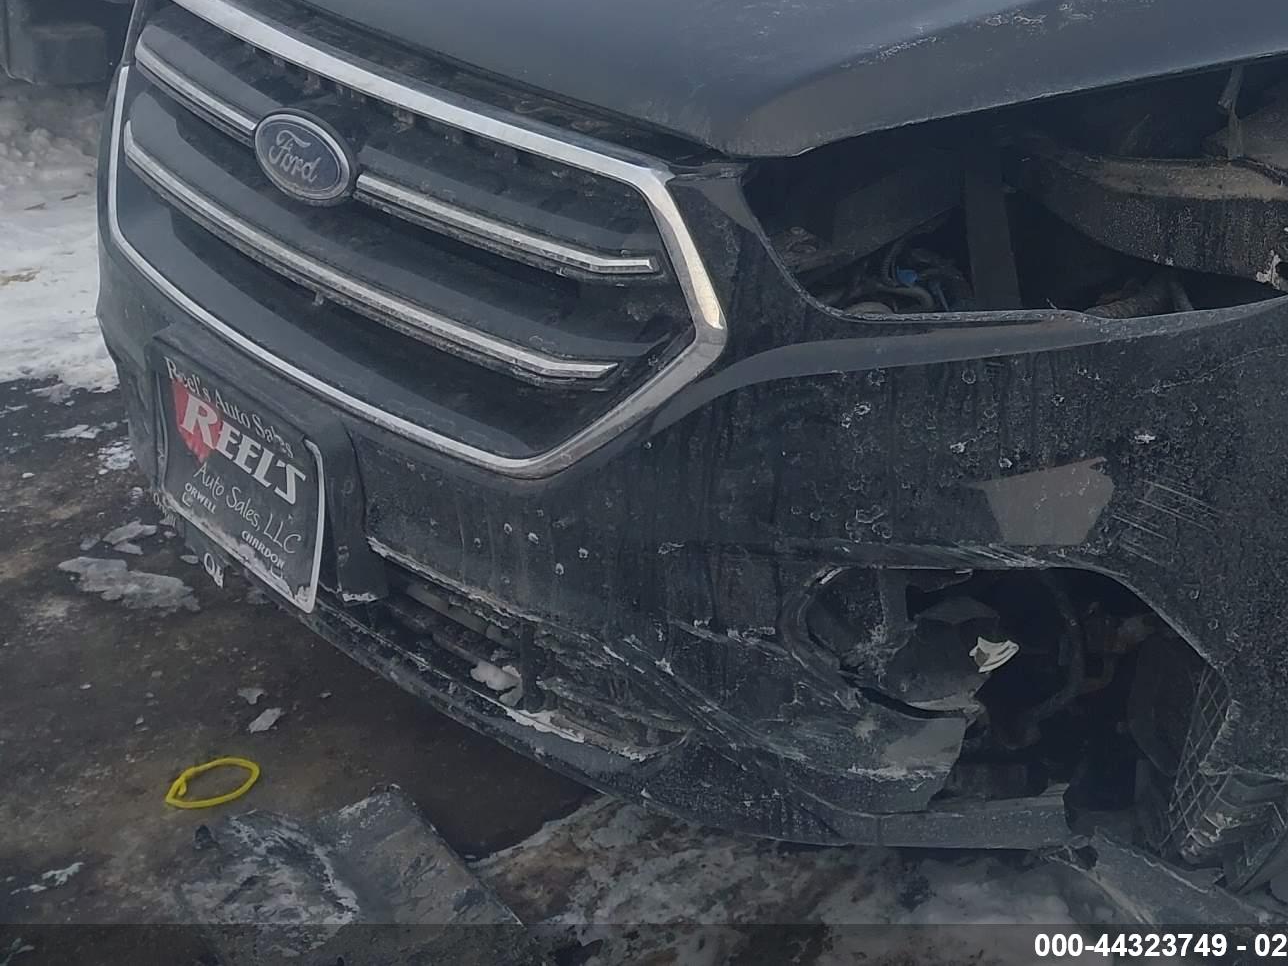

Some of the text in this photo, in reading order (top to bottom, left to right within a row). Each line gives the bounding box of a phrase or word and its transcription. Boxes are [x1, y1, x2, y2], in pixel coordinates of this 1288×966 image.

[268, 129, 322, 183] Ford
[215, 389, 251, 429] Auto
[180, 393, 307, 505] REEL'S
[184, 482, 217, 514] ORWELL
[193, 461, 225, 500] Auto
[226, 486, 261, 531] Sales,
[263, 513, 302, 554] LLC
[241, 530, 286, 569] CHARDON
